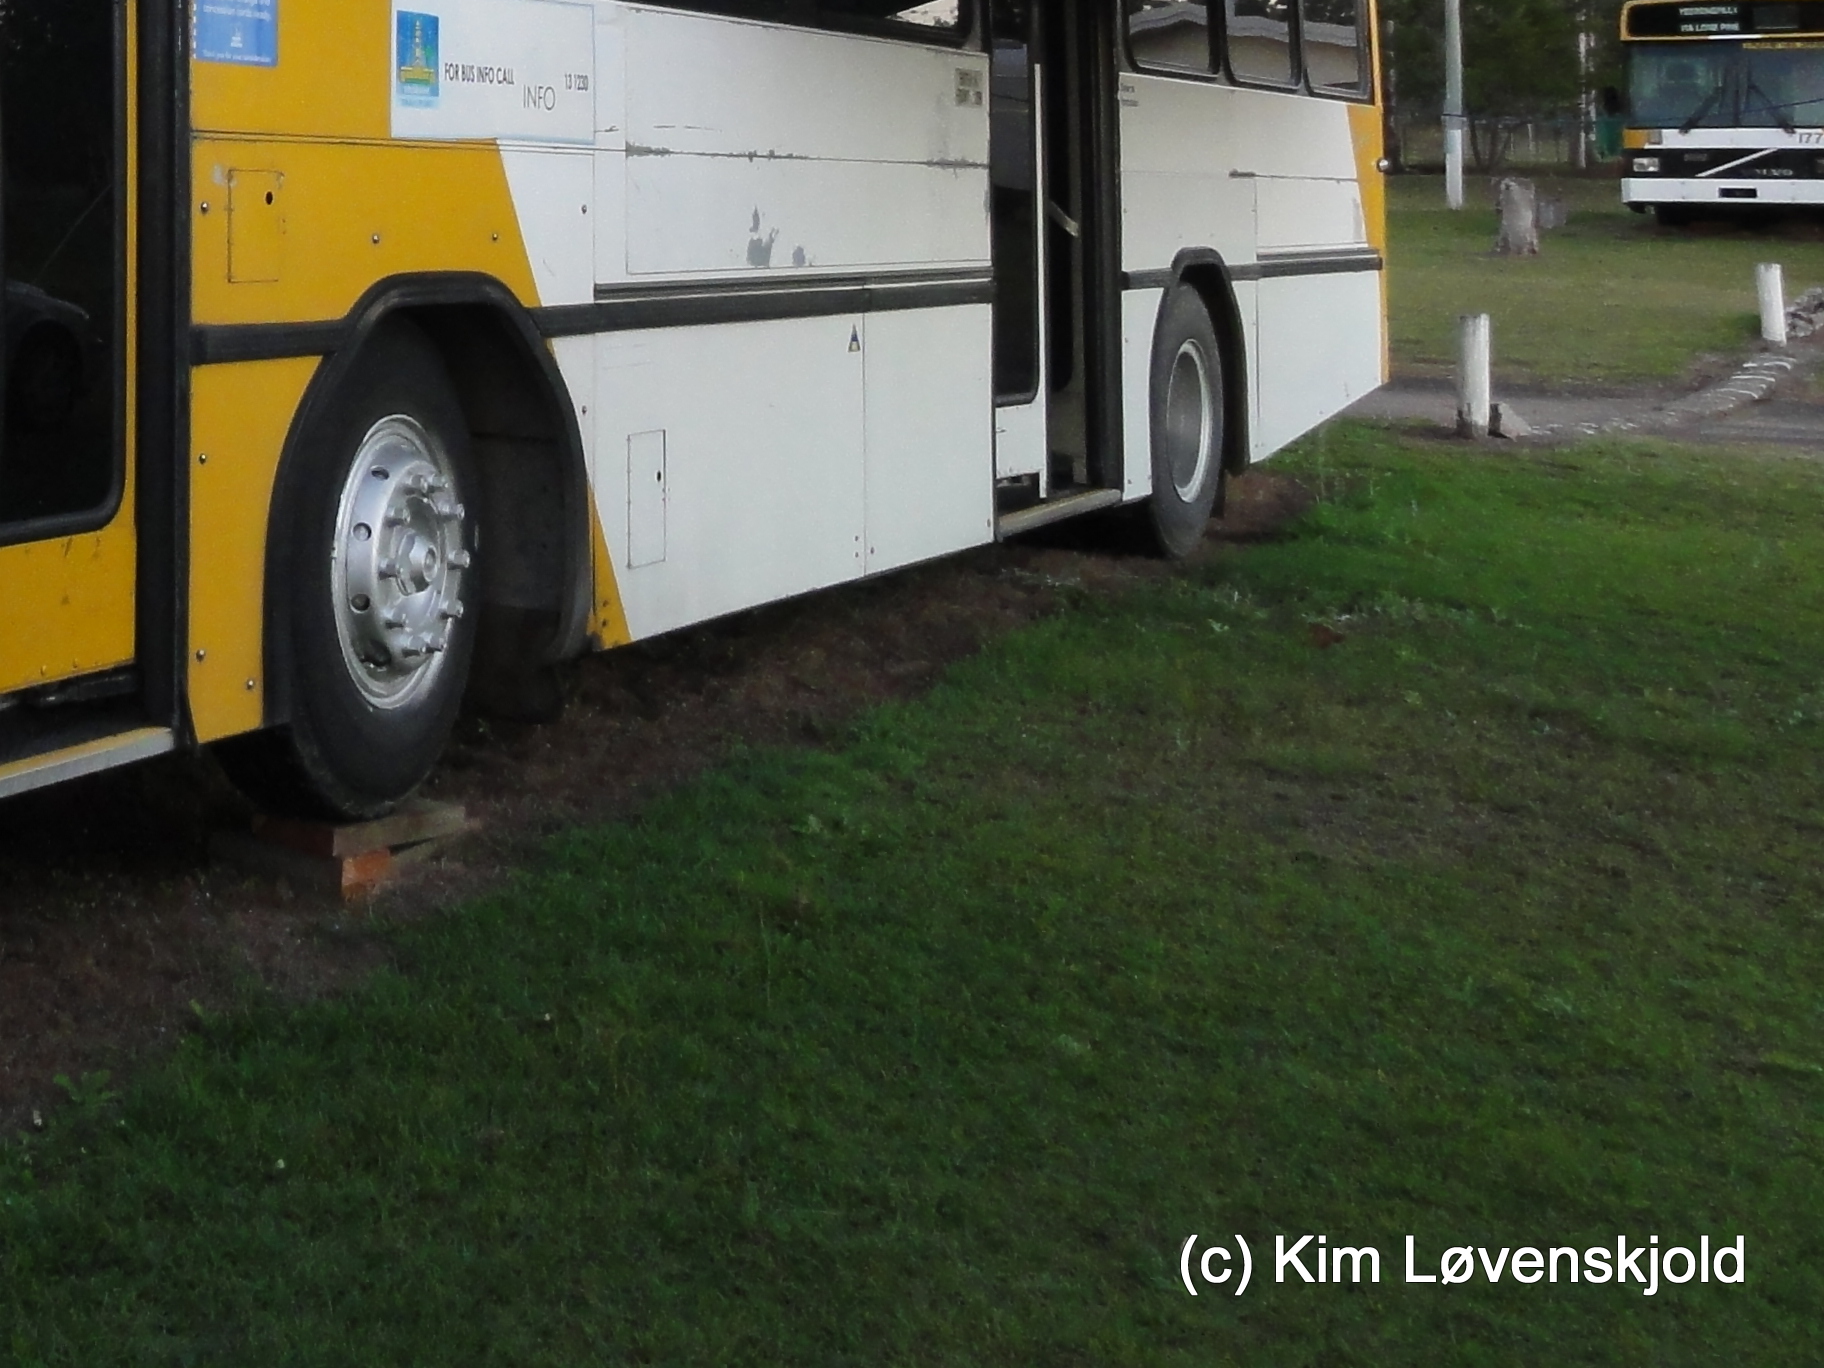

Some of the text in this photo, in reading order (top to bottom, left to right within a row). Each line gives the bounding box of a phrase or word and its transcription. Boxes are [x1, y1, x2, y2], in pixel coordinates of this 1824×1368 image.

[444, 62, 515, 85] FOR BUS INFO CALL
[523, 84, 555, 111] INFO
